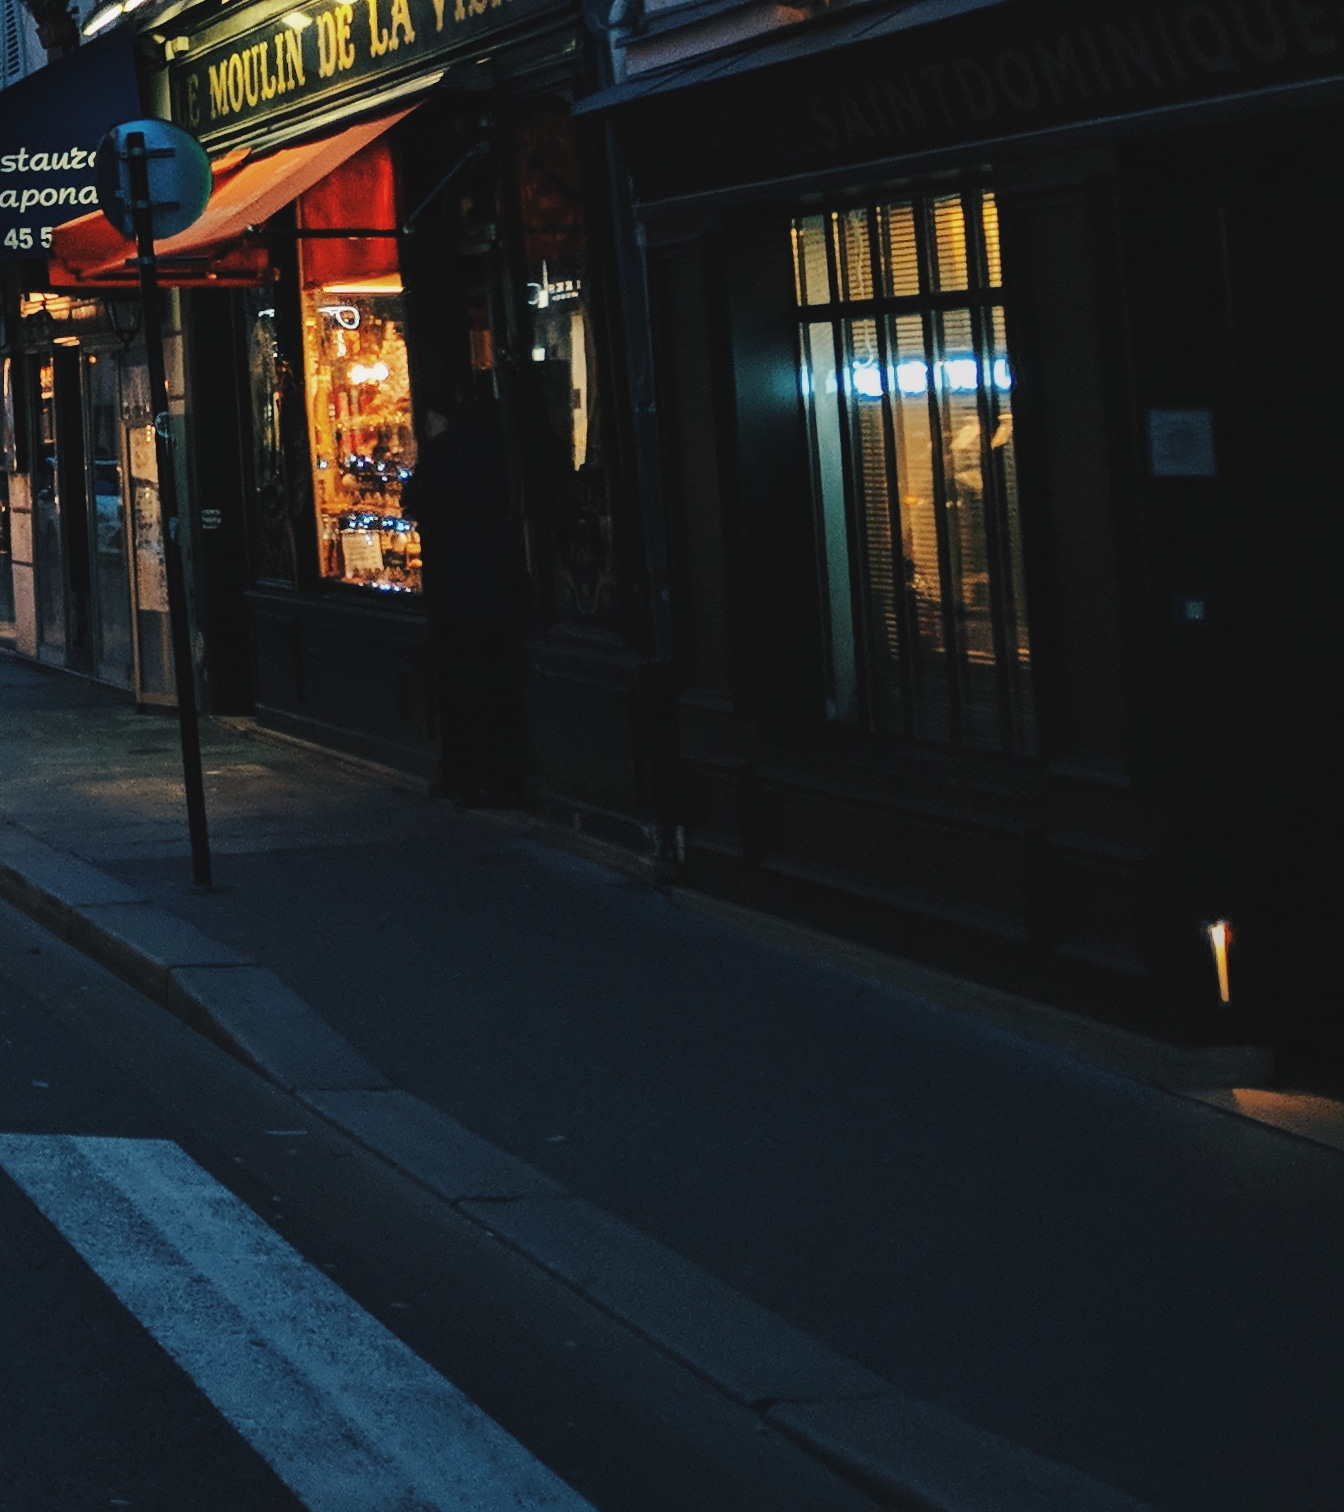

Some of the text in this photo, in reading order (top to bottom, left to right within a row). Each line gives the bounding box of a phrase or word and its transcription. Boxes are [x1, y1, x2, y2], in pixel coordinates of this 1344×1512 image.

[208, 27, 306, 118] MOULIN
[317, 4, 356, 79] DE
[4, 228, 33, 250] 45
